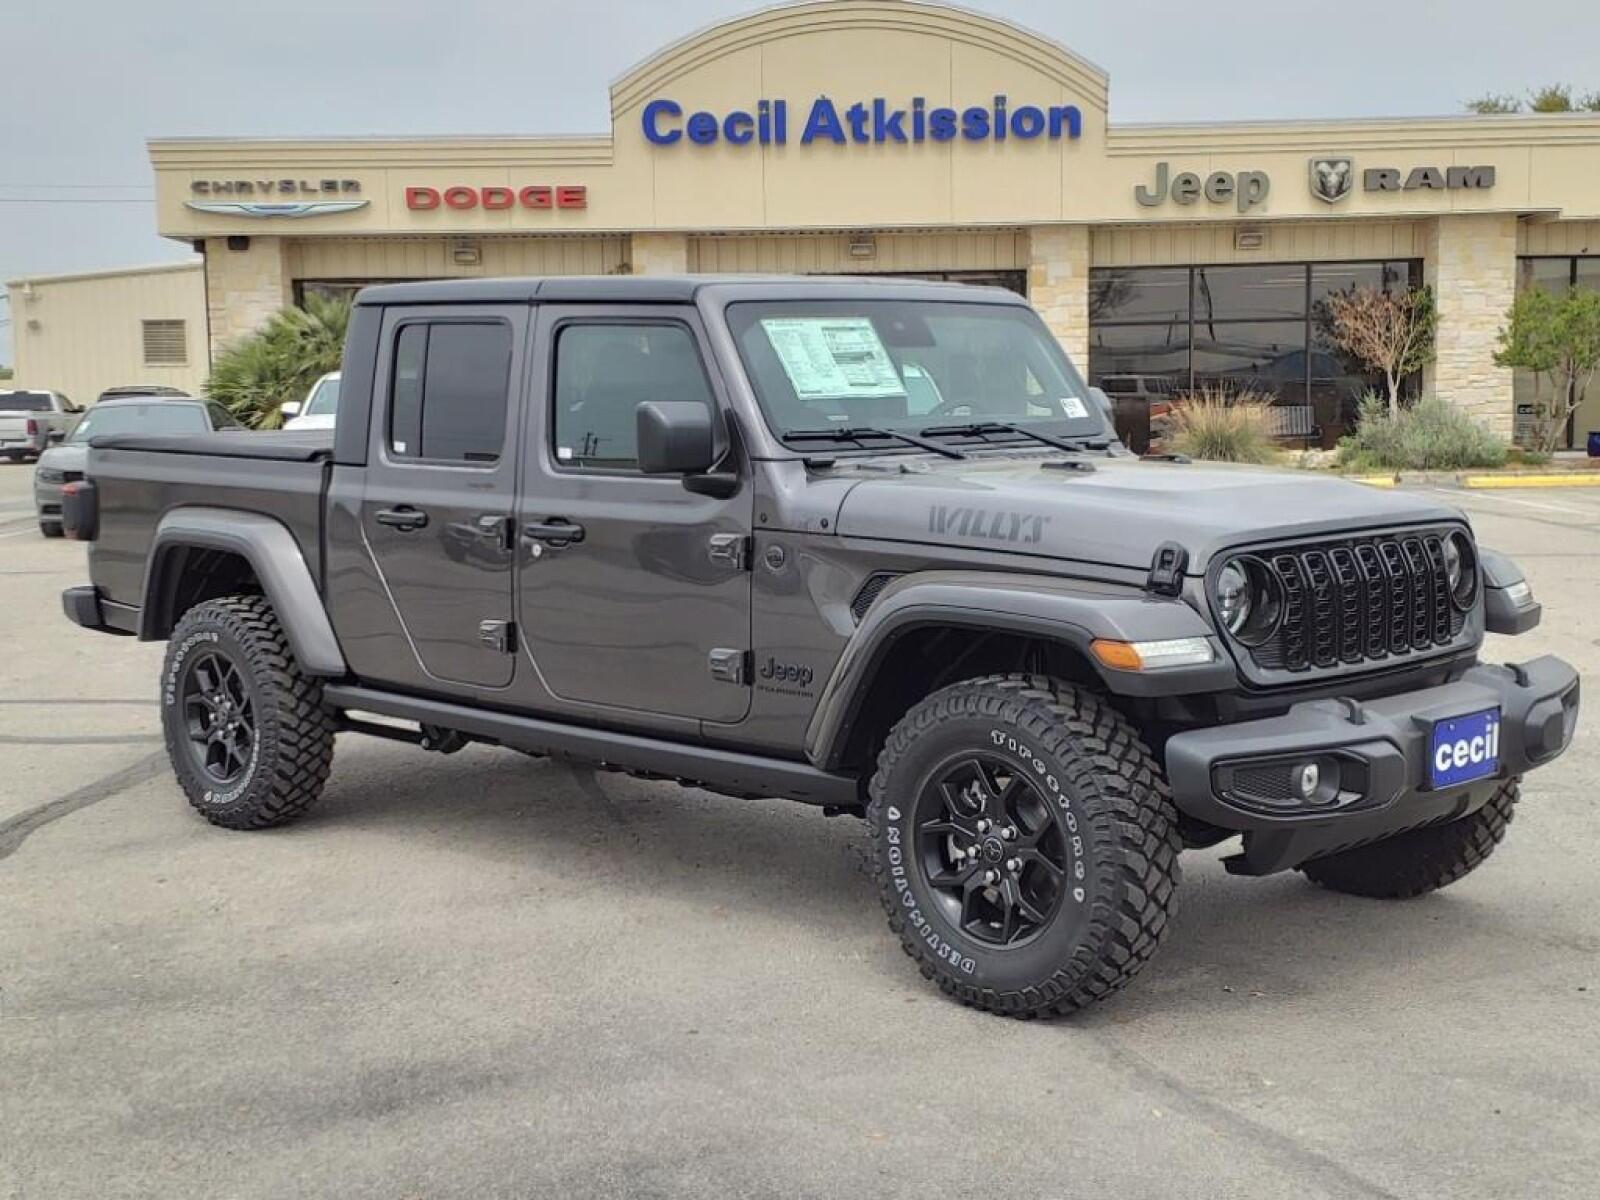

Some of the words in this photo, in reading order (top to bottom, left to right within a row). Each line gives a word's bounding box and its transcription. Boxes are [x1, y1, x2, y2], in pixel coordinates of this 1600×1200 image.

[642, 99, 788, 146] Cecil
[800, 95, 1082, 145] Atkission
[190, 179, 362, 194] CHRYSLER
[1135, 161, 1270, 213] Jeep
[1363, 165, 1496, 192] RAM
[405, 185, 587, 210] DODGE
[928, 505, 1052, 545] WILLYS
[760, 656, 814, 688] Jeep
[1436, 722, 1499, 772] cecil
